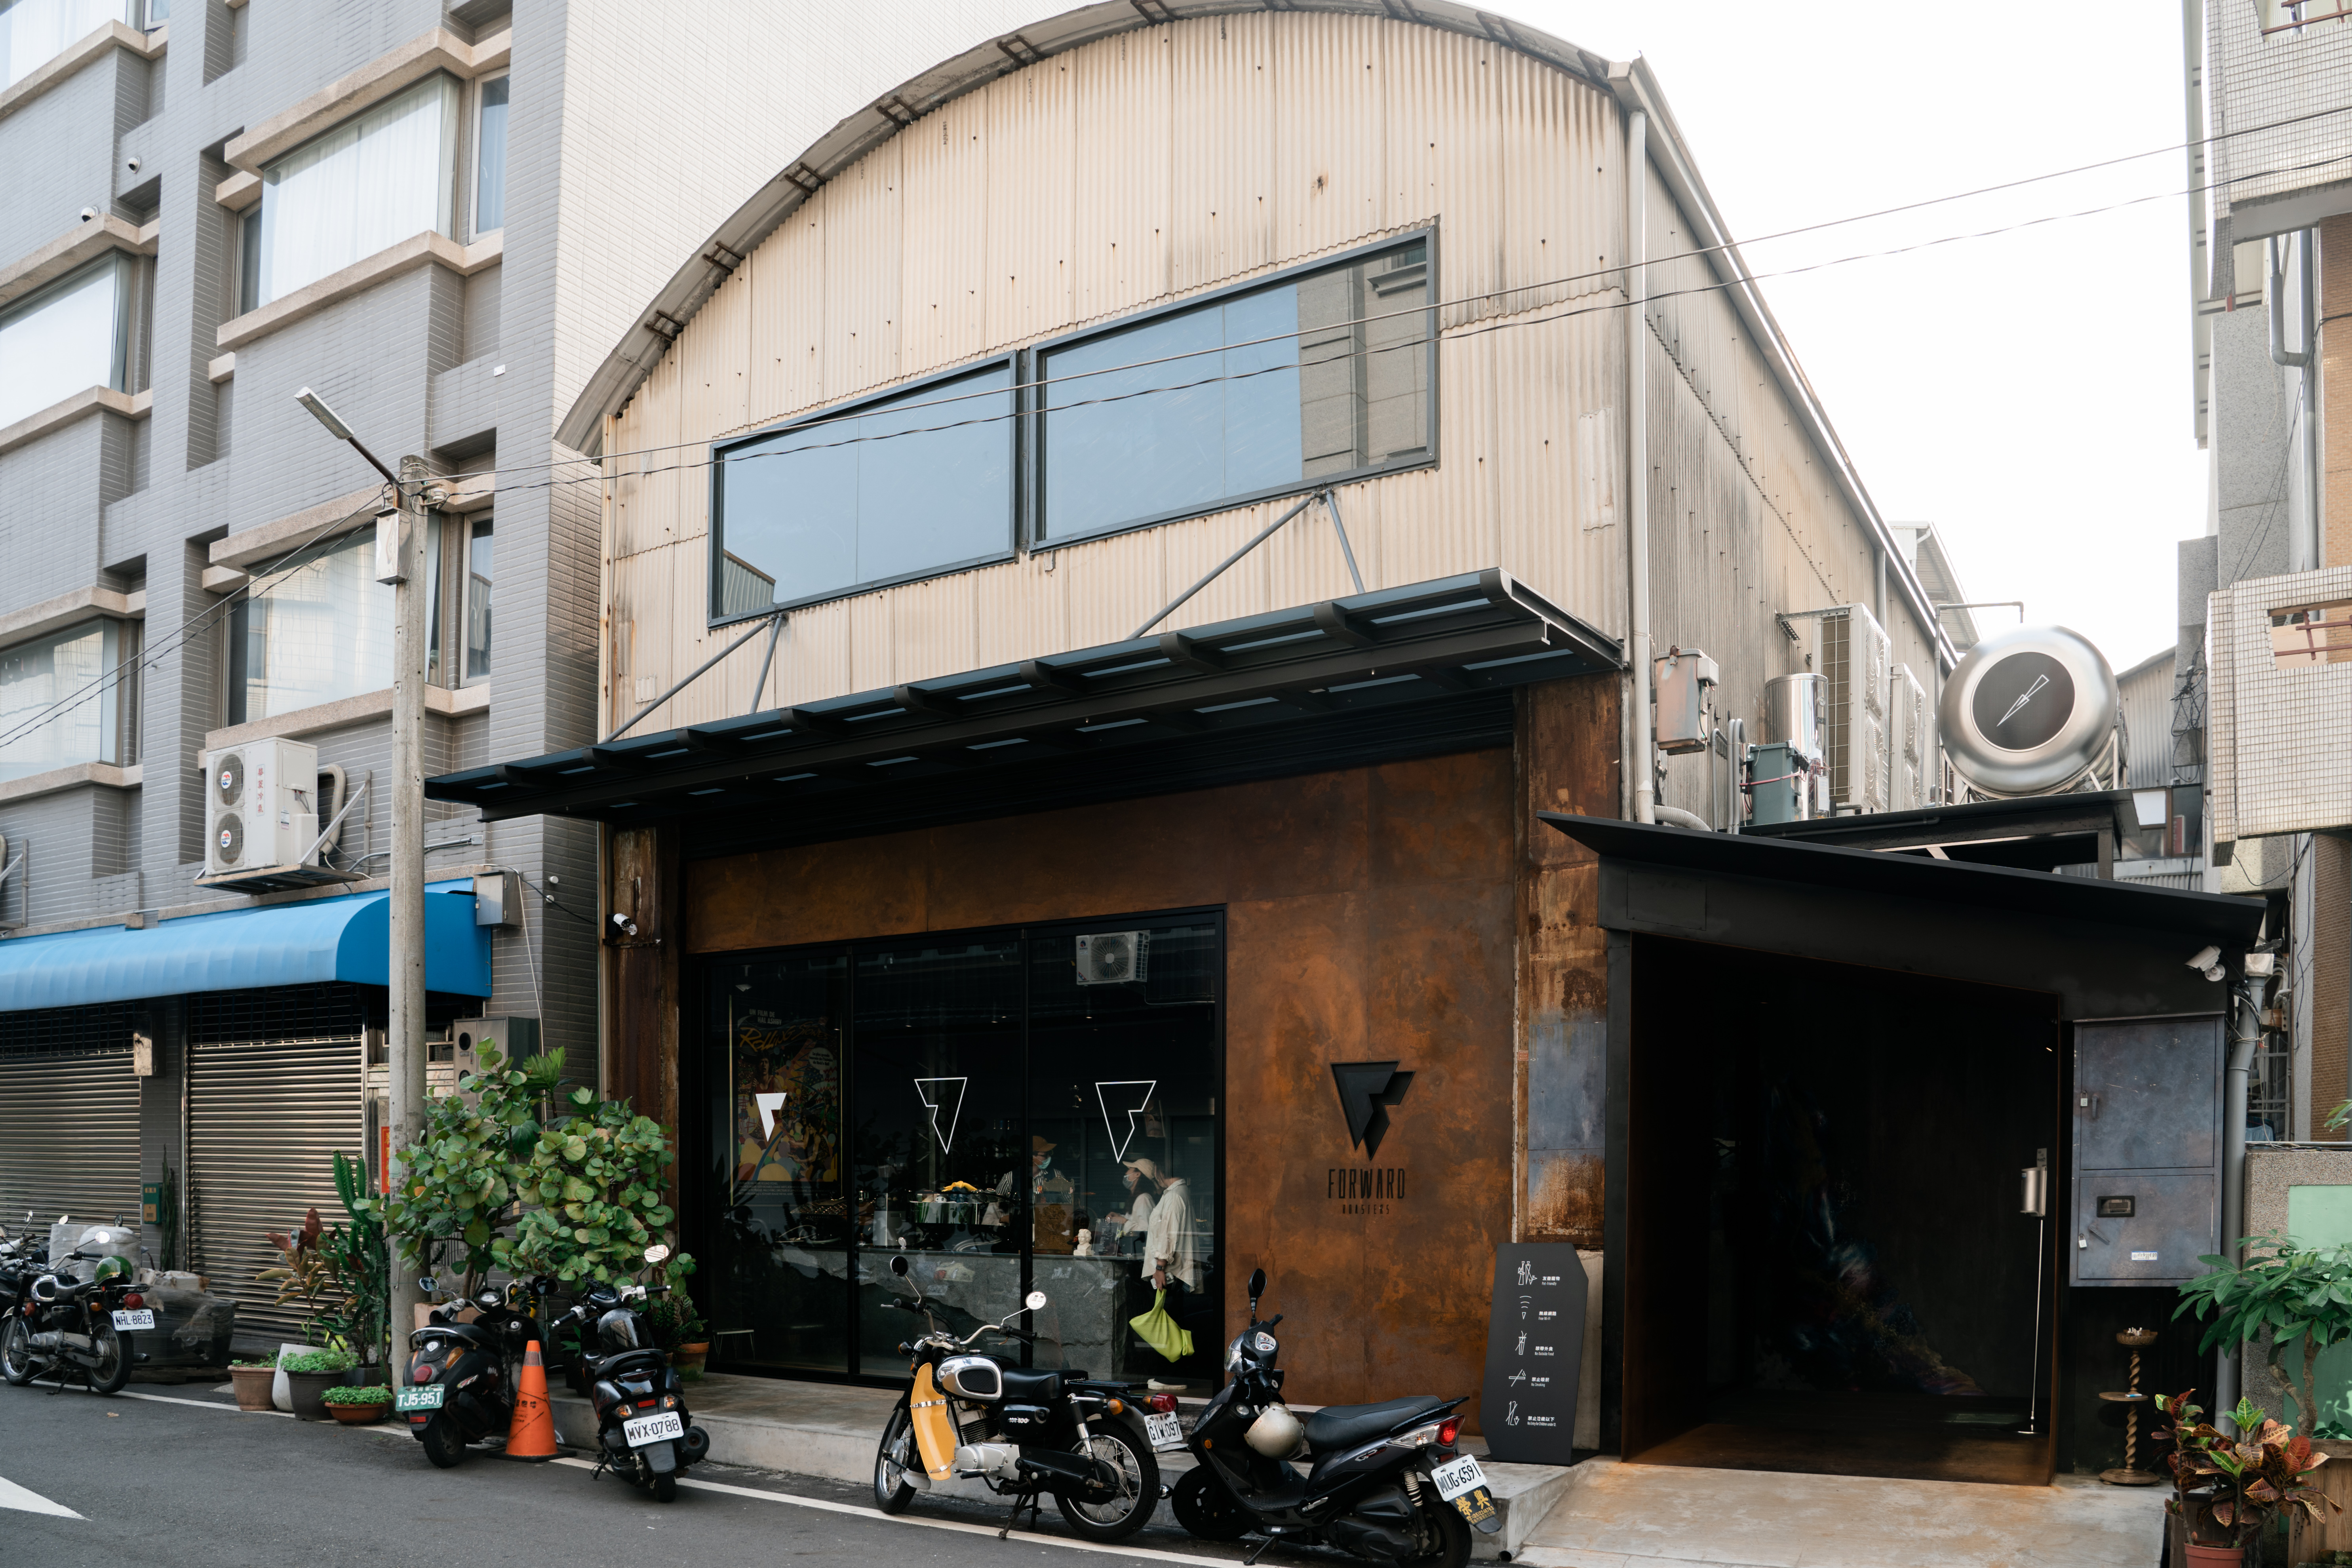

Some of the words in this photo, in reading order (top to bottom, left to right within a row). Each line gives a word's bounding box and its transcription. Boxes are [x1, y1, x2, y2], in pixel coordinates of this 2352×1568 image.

[1328, 1168, 1405, 1199] FORWARD
[1343, 1204, 1389, 1214] ROASTERS
[1456, 1489, 1490, 1516] 榮興
